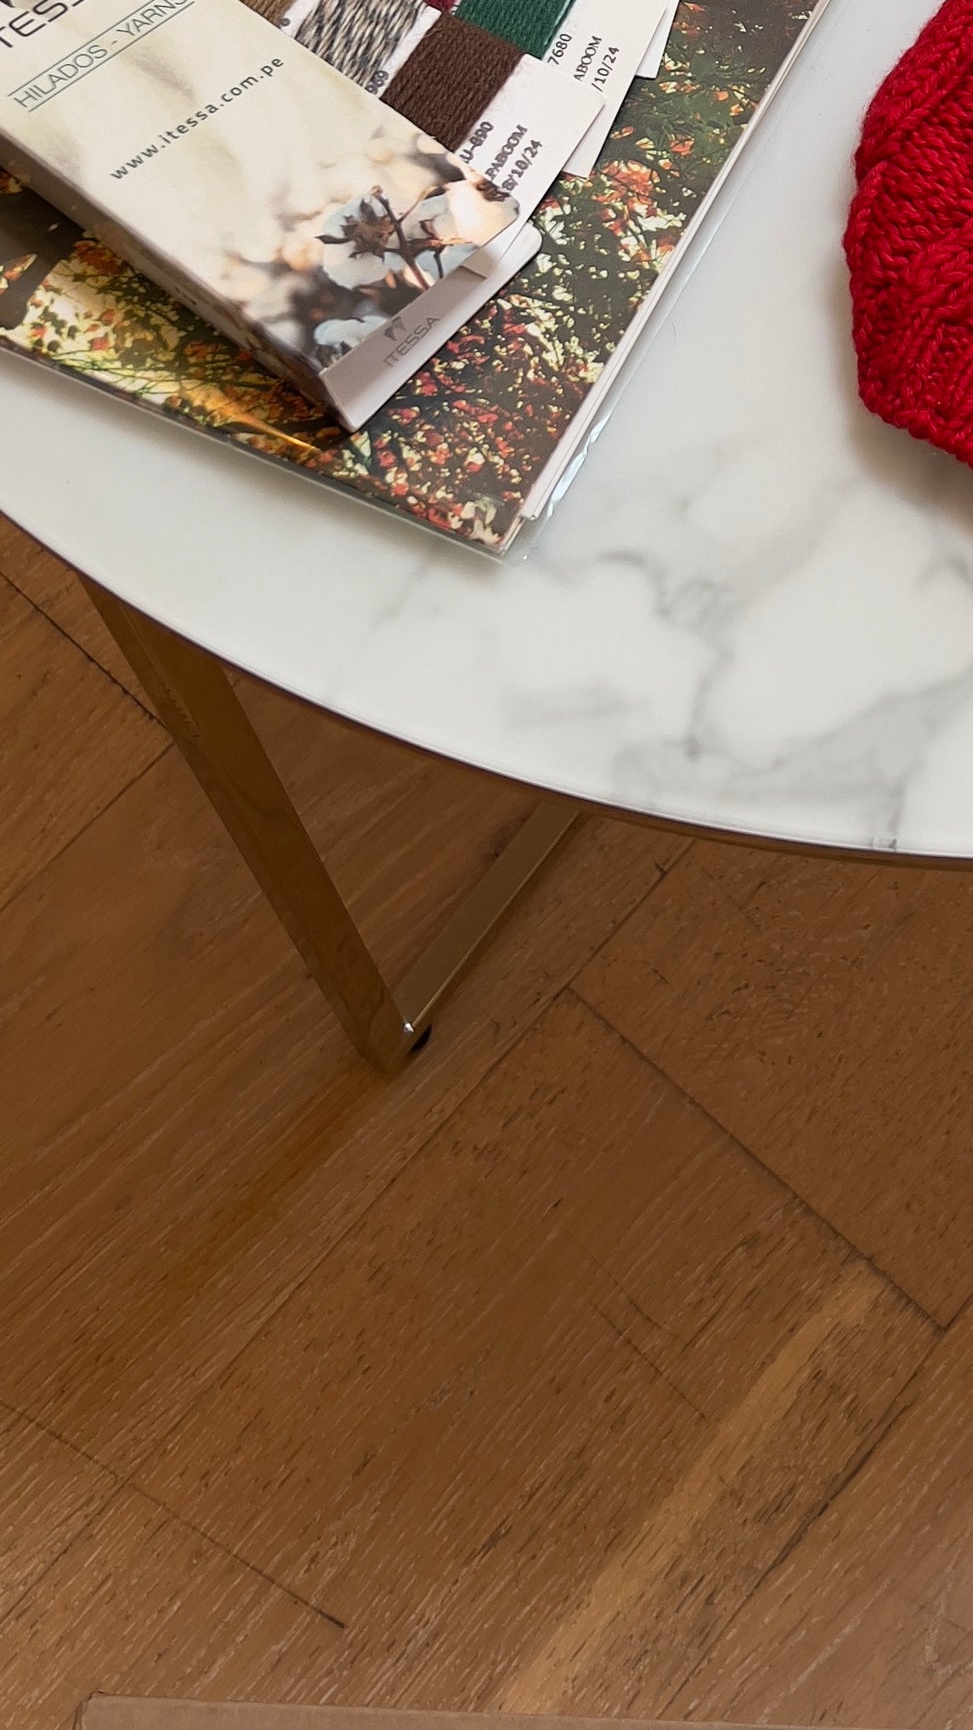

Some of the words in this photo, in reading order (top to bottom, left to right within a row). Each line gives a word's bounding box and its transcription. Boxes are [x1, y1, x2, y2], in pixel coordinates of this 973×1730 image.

[14, 44, 109, 108] HILADOS
[573, 35, 603, 82] ABOOM
[110, 56, 285, 180] www.itessa.com.pe
[383, 317, 441, 368] ITESSA
